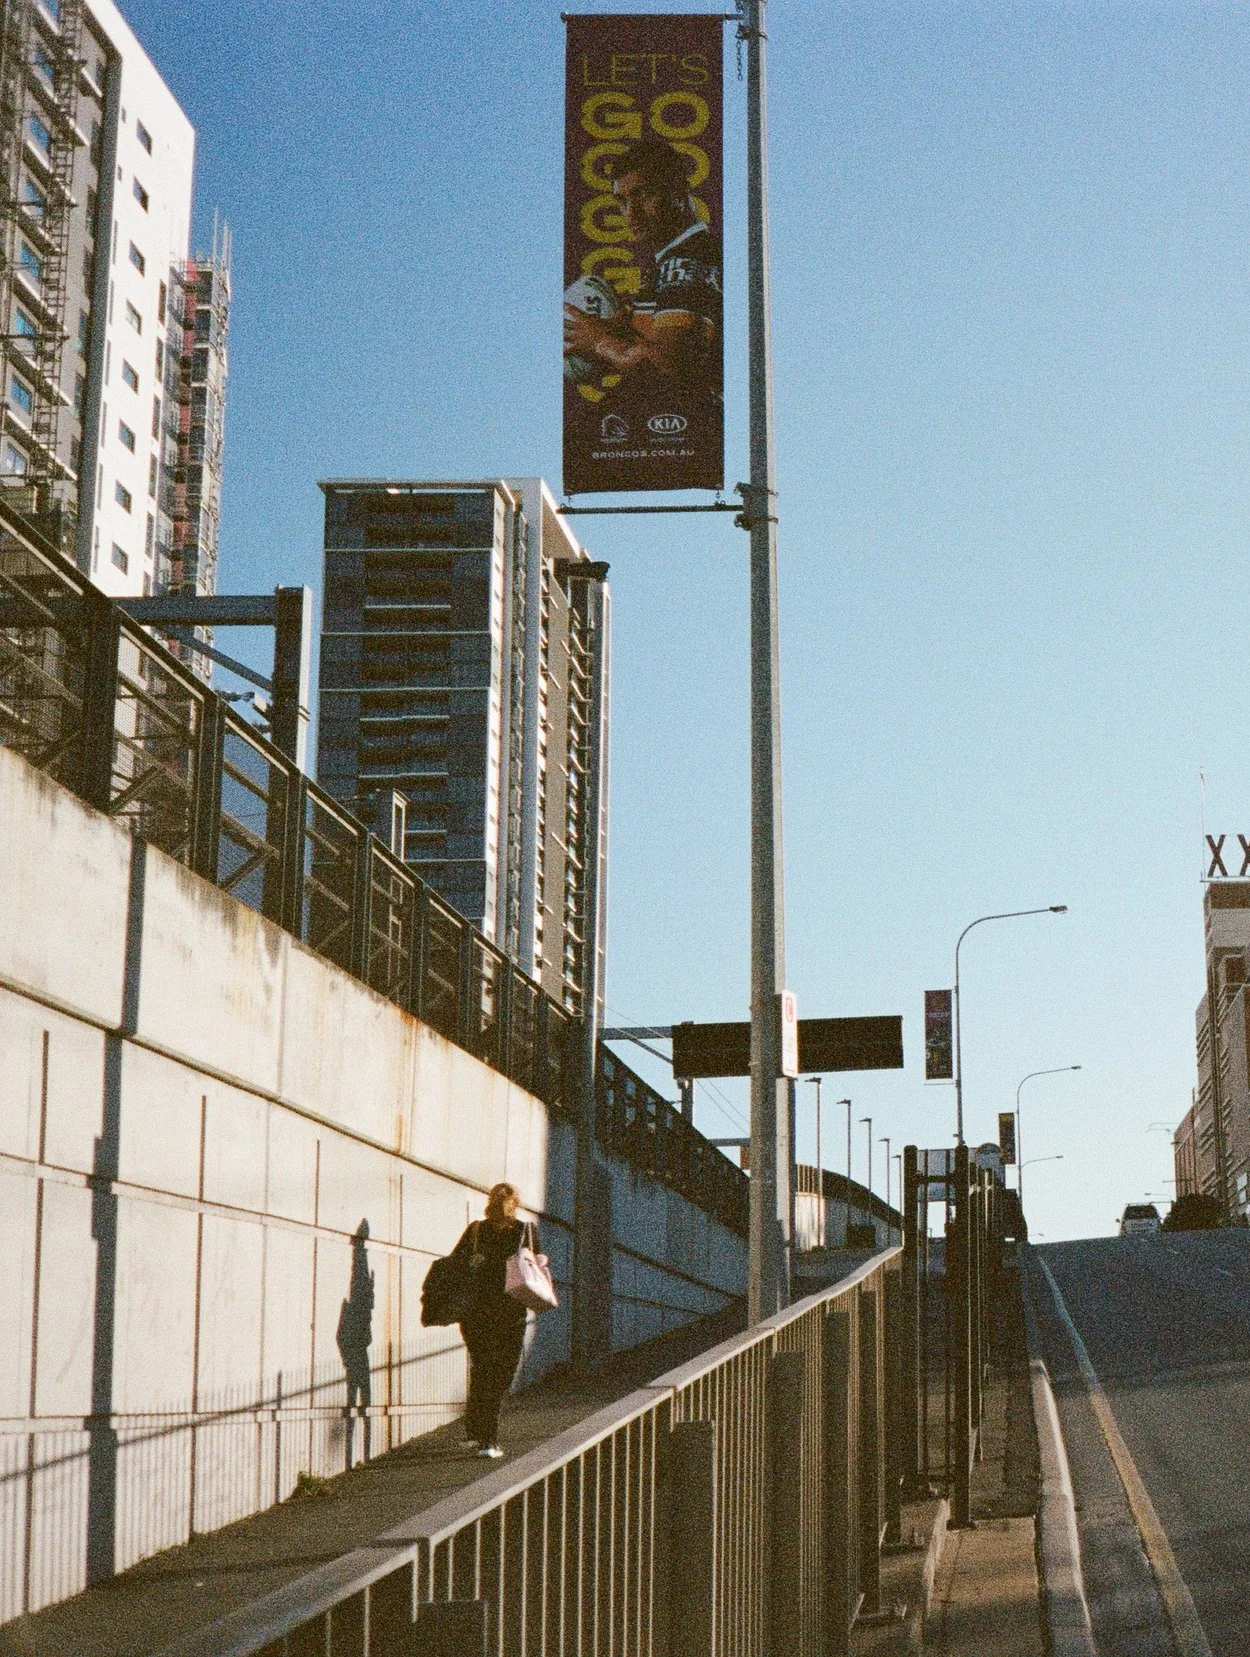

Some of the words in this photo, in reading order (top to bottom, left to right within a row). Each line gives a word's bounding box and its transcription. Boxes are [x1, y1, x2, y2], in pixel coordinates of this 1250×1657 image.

[582, 53, 710, 86] LET'S
[580, 91, 711, 139] GO
[653, 418, 681, 430] KIA
